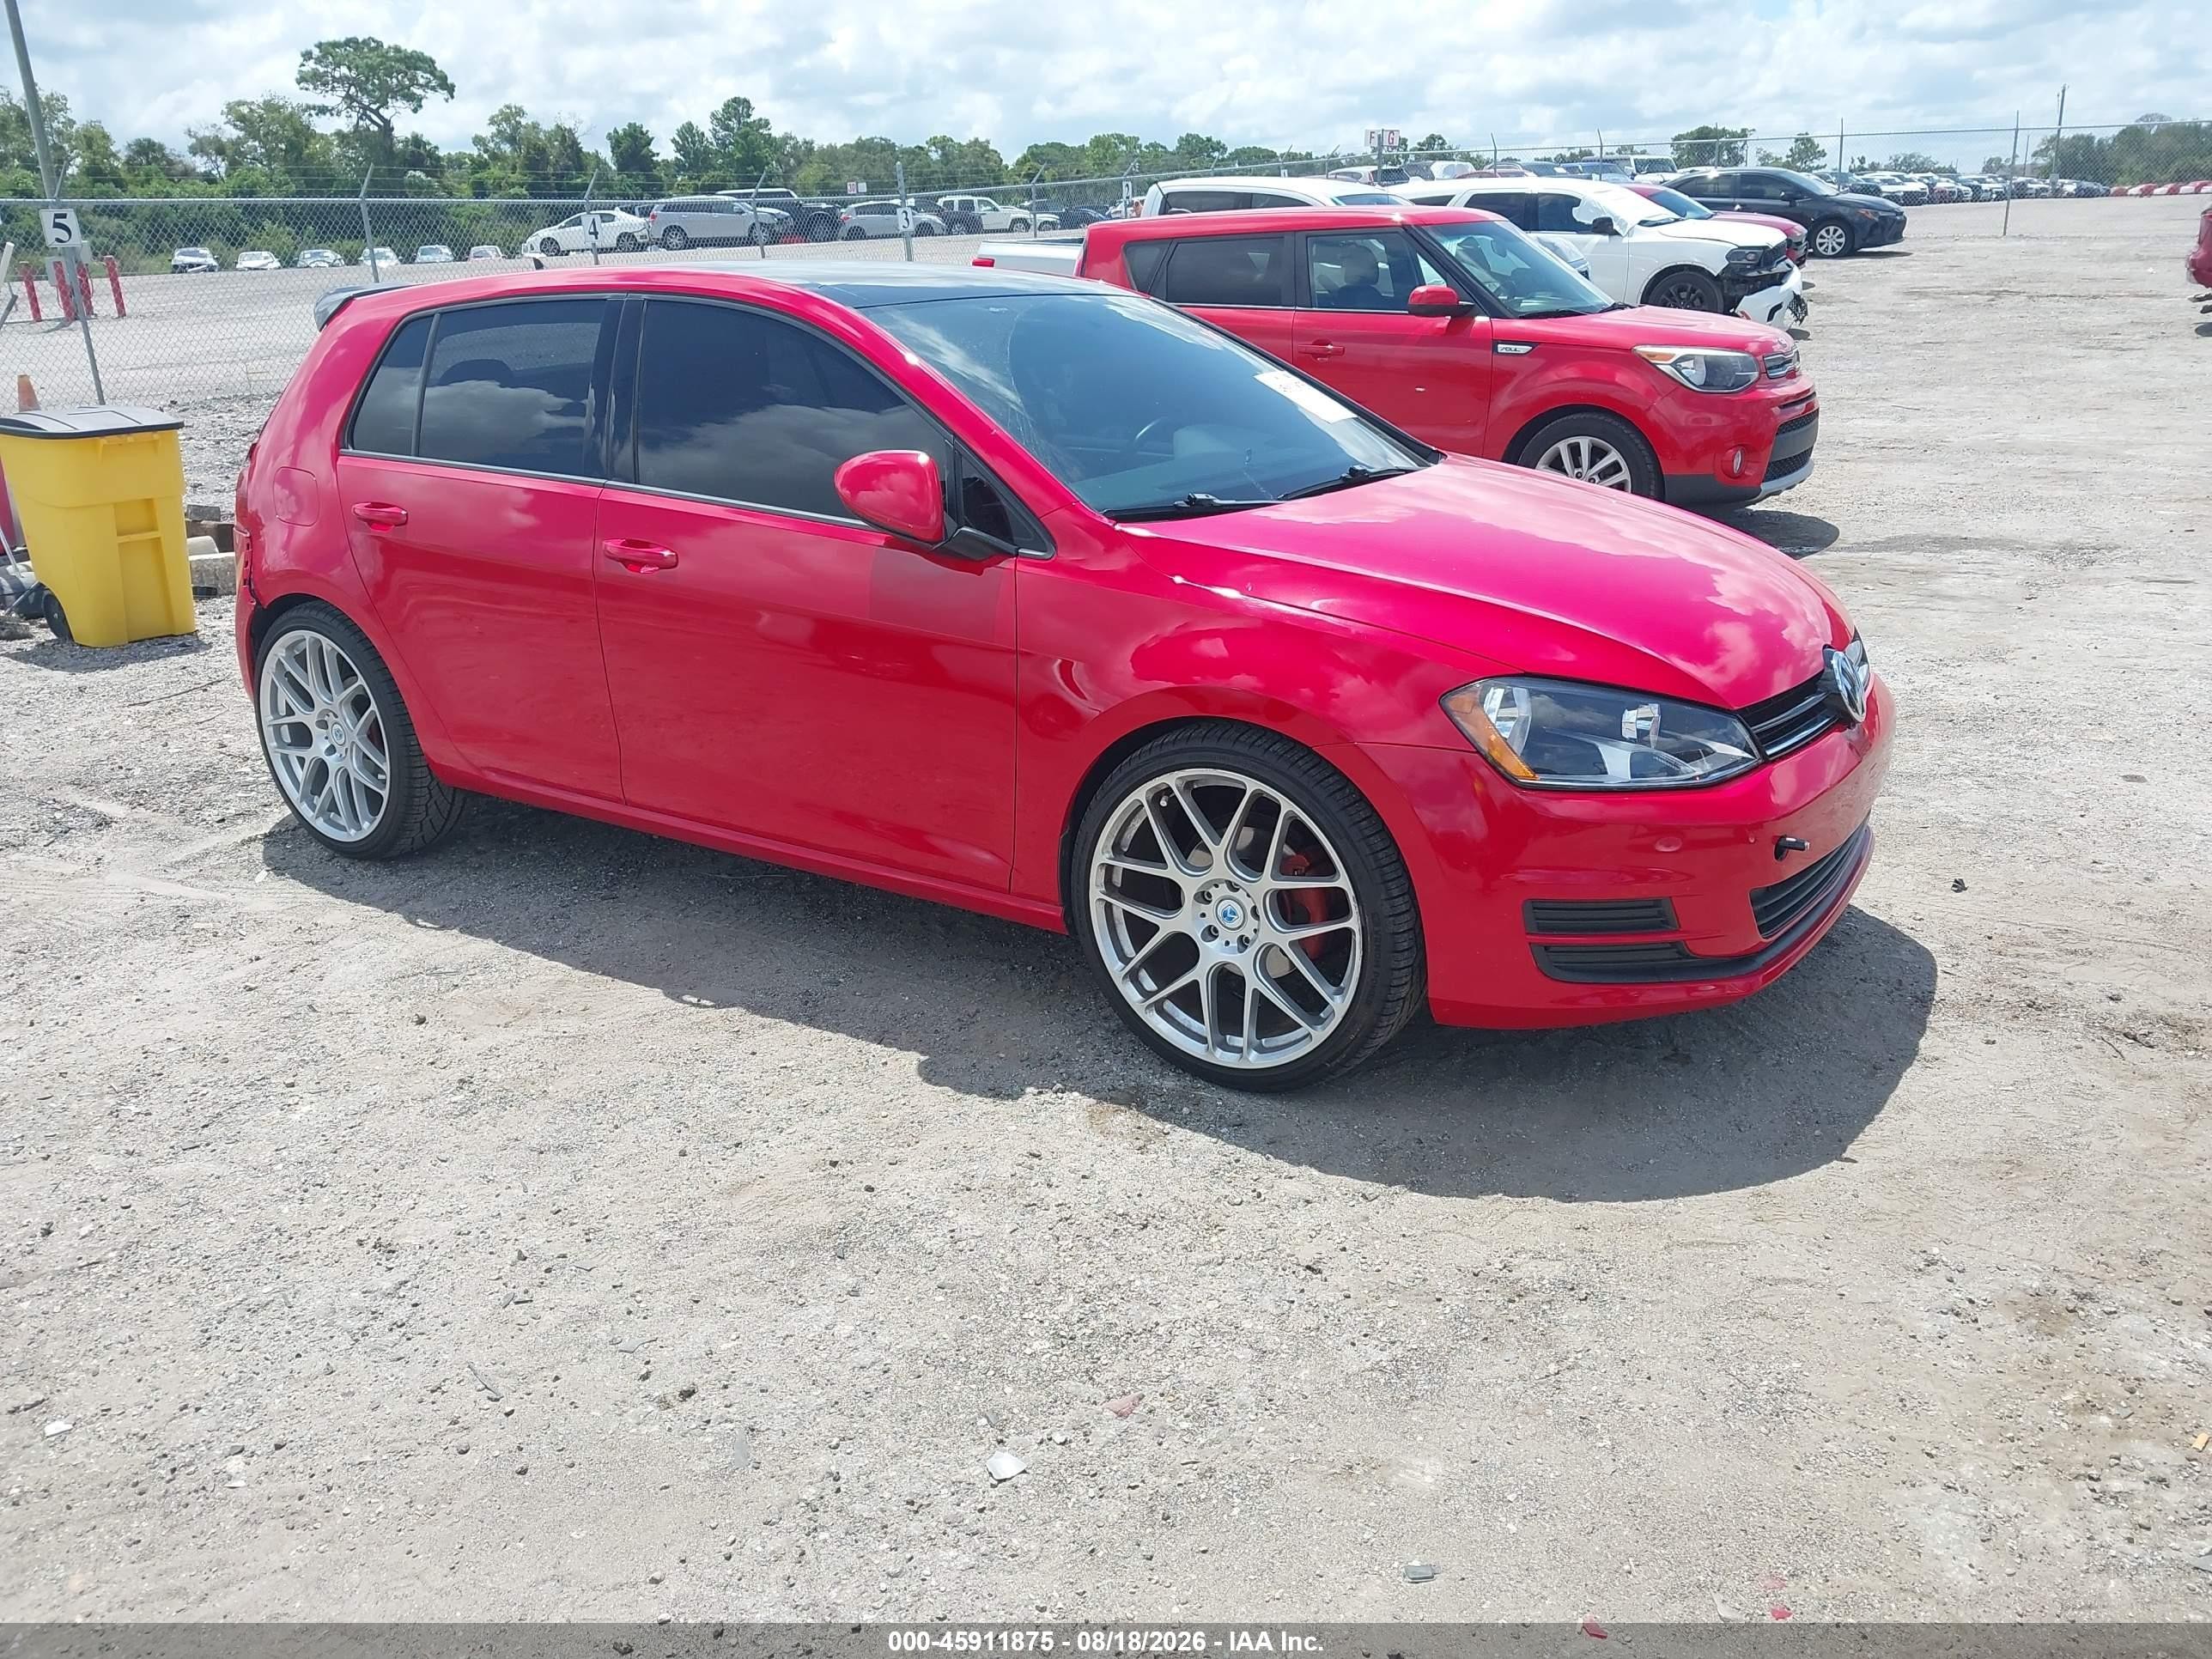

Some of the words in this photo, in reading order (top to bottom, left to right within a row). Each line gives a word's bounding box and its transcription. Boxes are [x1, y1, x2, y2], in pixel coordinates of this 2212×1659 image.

[1369, 131, 1376, 144] F
[1388, 131, 1395, 145] G
[52, 213, 72, 244] 5
[588, 218, 599, 240] 4
[902, 210, 910, 229] 3
